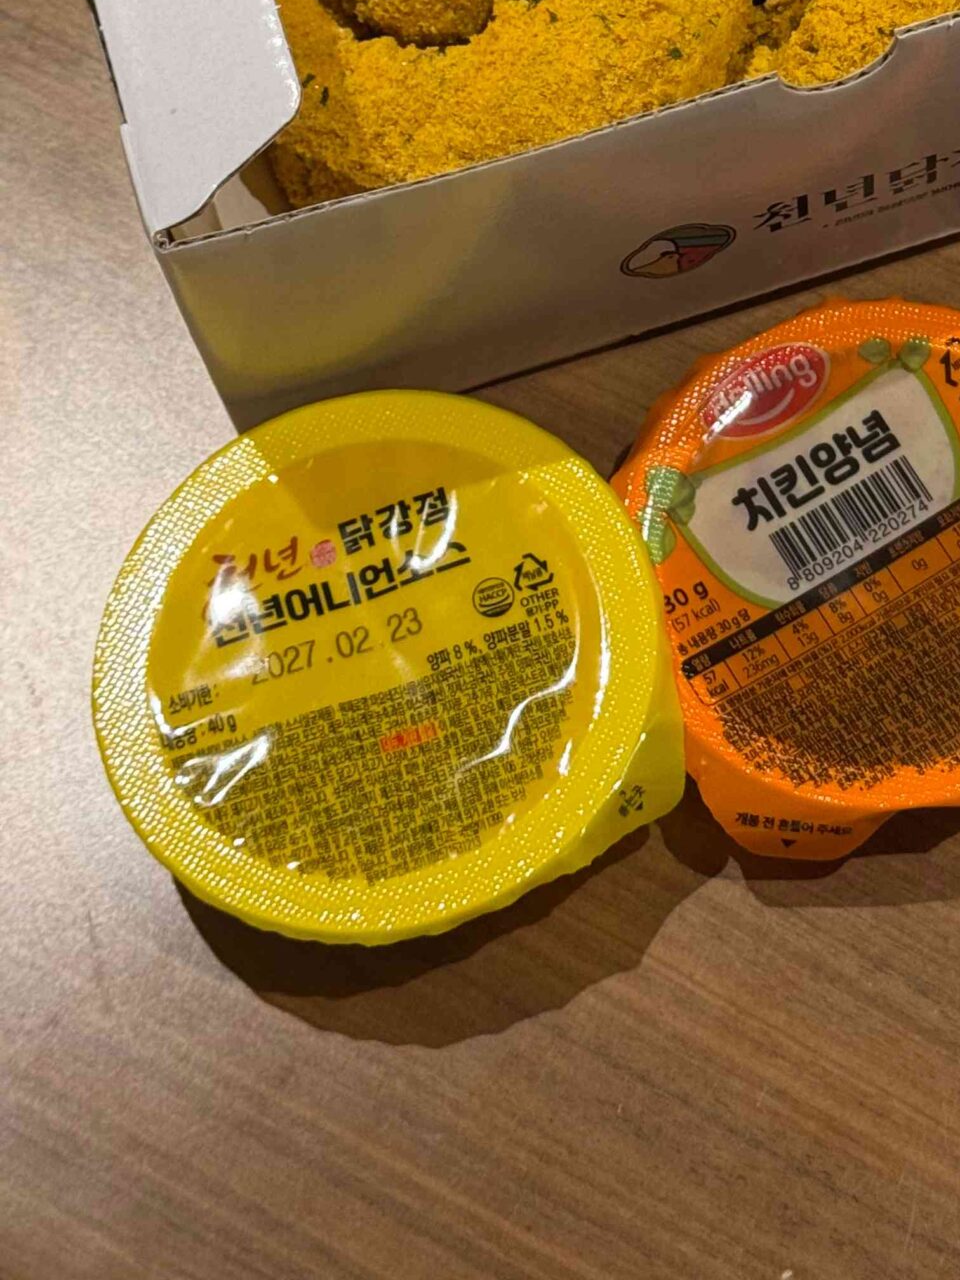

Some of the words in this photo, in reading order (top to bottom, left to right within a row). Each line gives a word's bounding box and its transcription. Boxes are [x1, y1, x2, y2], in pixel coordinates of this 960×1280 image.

[731, 410, 900, 531] 치킨양념
[478, 588, 507, 603] HACCP
[519, 587, 559, 608] OTHER
[426, 647, 451, 672] 양파
[483, 619, 531, 650] 양파분말
[533, 613, 554, 633] 1.5
[205, 713, 225, 734] 40
